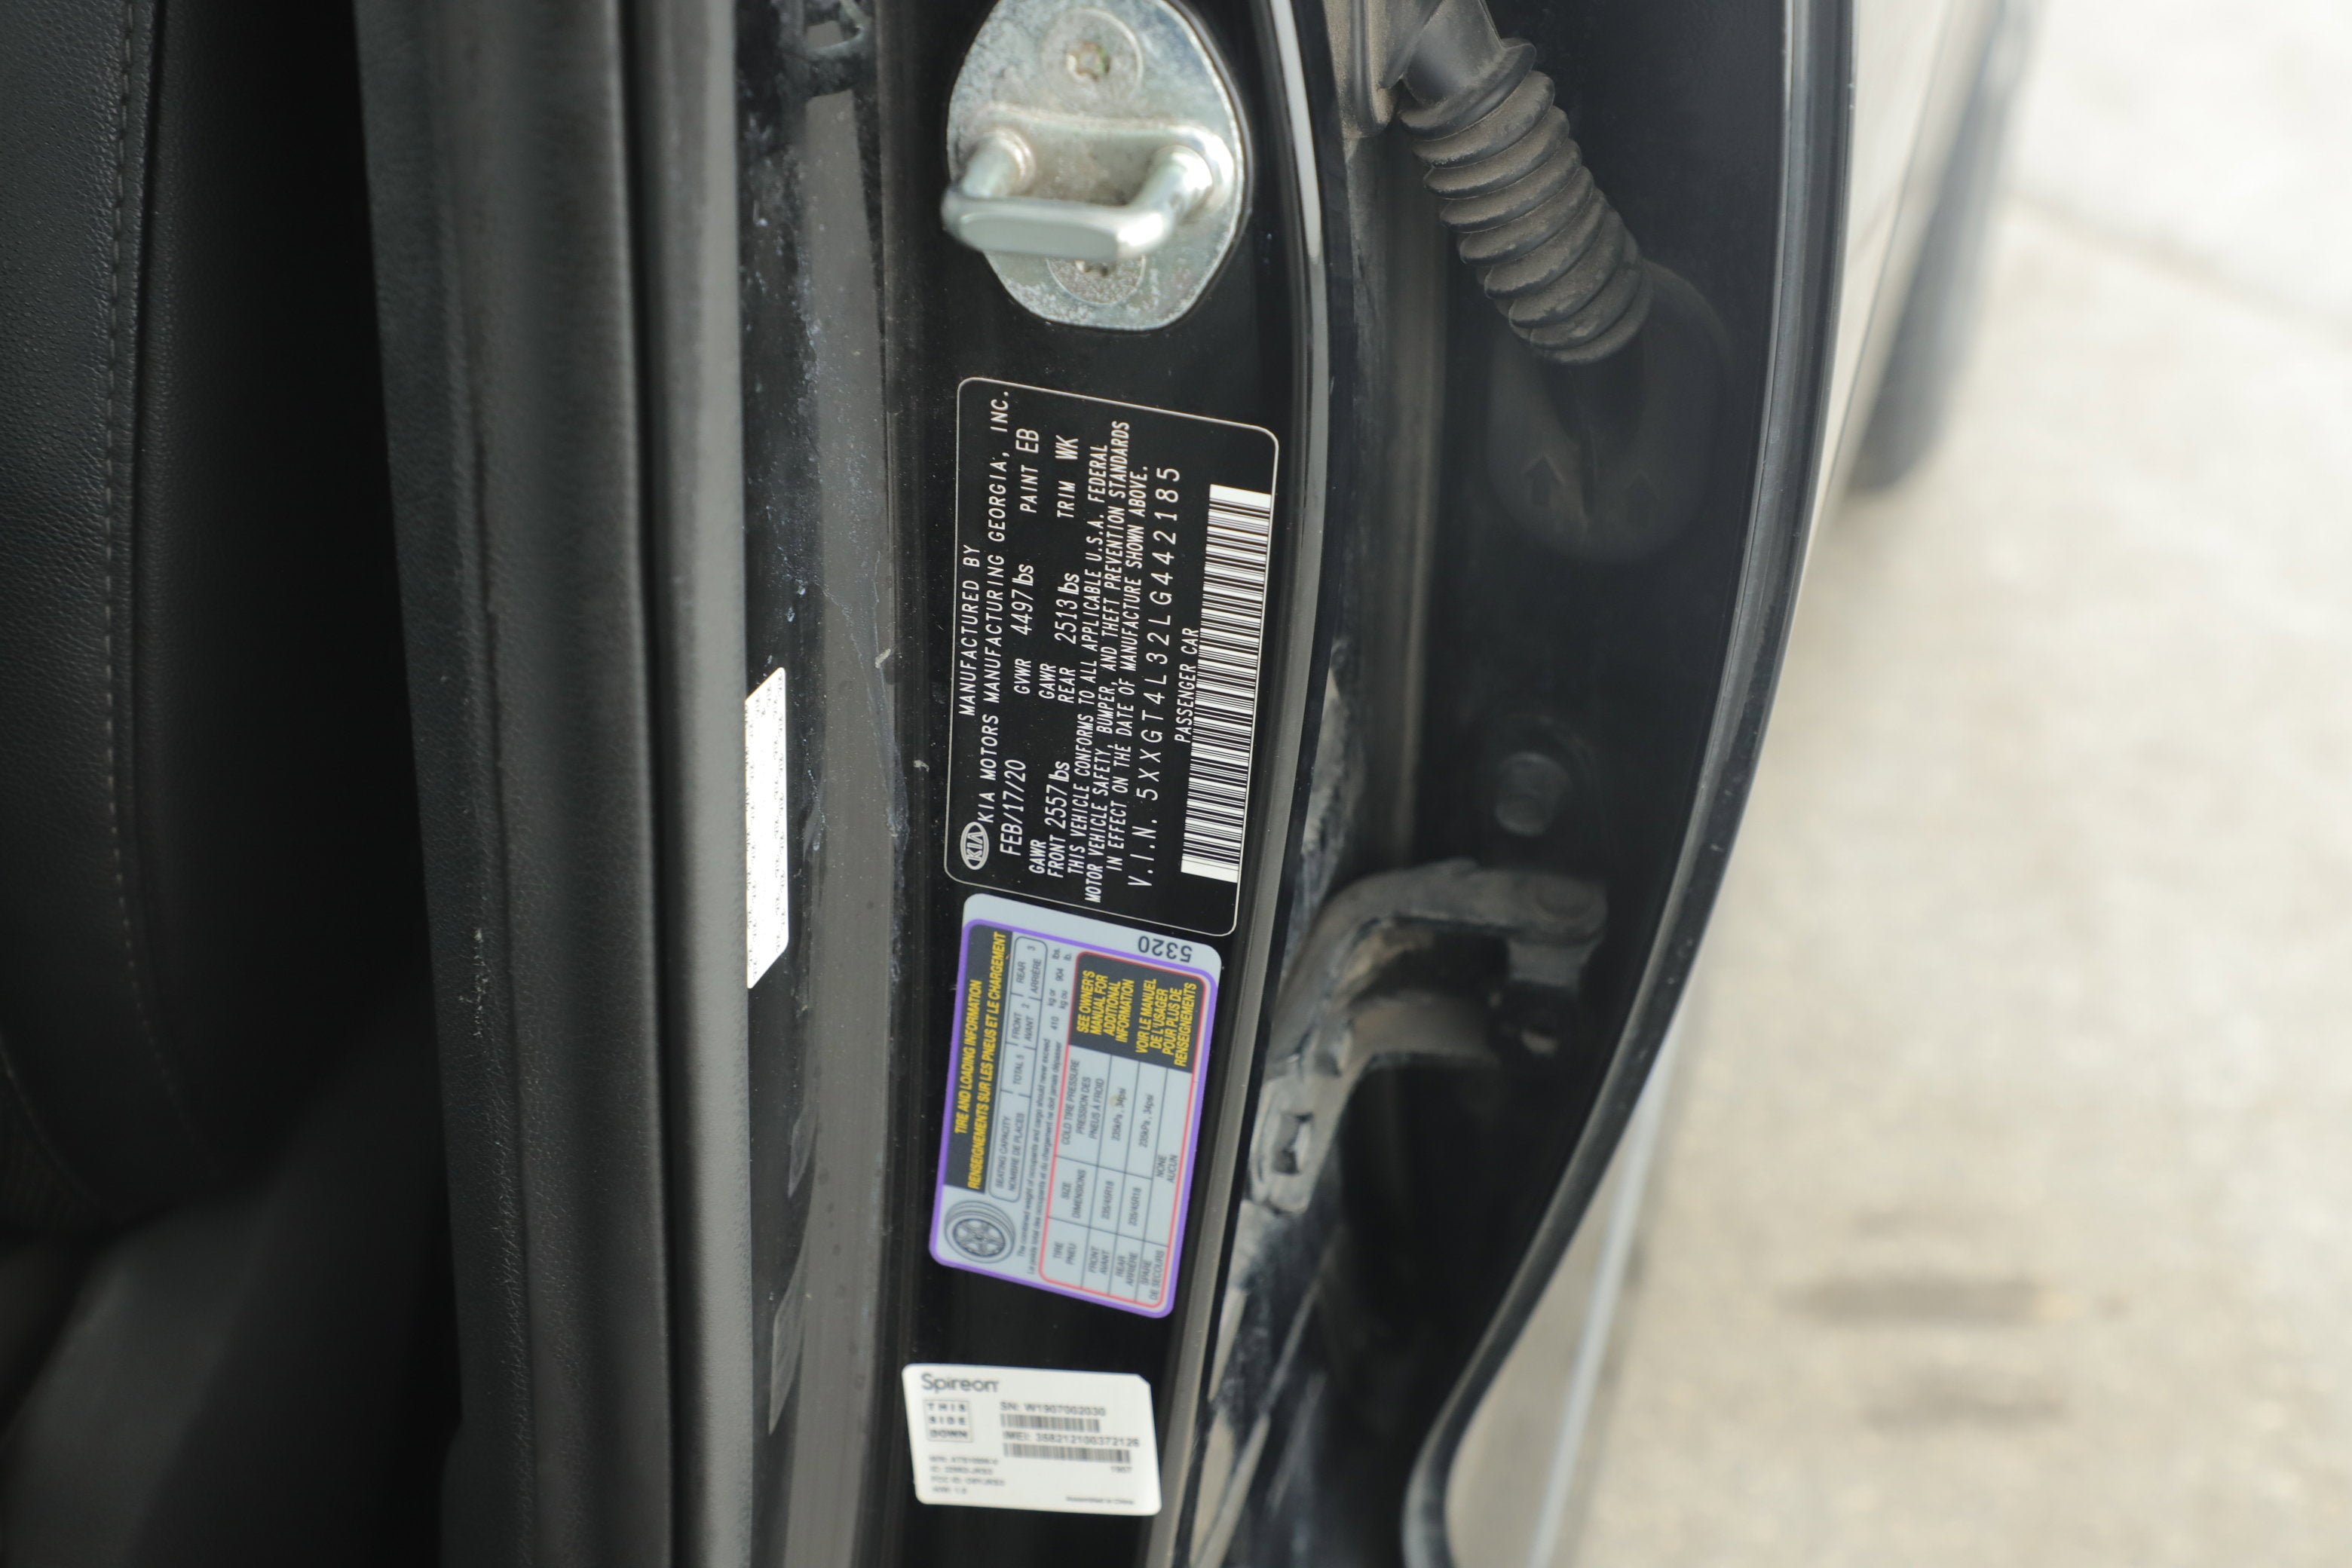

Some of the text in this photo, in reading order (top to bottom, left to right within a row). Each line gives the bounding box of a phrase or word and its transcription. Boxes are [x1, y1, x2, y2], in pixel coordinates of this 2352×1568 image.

[1015, 427, 1039, 513] PAINT EB
[1055, 434, 1078, 519] TRIM WK
[958, 544, 980, 716] MANUFACTURED BY
[978, 388, 1009, 823] KIA MOTORS MANUFACTURING GEORGIA, INC.
[1010, 562, 1034, 694] GVWR 4497 lbs
[1054, 571, 1080, 703] REAR 2513 lbs
[1067, 442, 1107, 875] THIS VEHICLE CONFORMS TO ALL APPLICABLE U.S.A. FEDERAL
[1085, 420, 1129, 903] MOTOR VEHICLE SAFETY, BUMPER, AND THEFT PREVENTION STANDARDS
[1039, 663, 1056, 700] GAWR
[1106, 464, 1148, 871] IN EFFECT ON THE DATE OF MANUFACTURE SHOWN ABOVE.
[1128, 466, 1180, 889] V.I.N. 5XXGT4L32LG442185
[1174, 626, 1199, 743] PASSENGER CAR
[1000, 757, 1026, 856] FEB/17/20
[1044, 759, 1070, 877] FRONT 2557 lbs
[1028, 838, 1046, 874] GAWR
[1016, 960, 1025, 983] REAR
[1028, 957, 1041, 993] ARRIÈRE
[1055, 967, 1064, 982] 904
[1137, 935, 1193, 963] 5320
[1012, 1012, 1021, 1039] FRONT
[1024, 1015, 1034, 1041] AVANT
[1047, 997, 1056, 1006] kg
[1050, 1015, 1059, 1030] 410
[1059, 999, 1067, 1009] kg
[1076, 969, 1095, 1033] SEE OWNER'S
[1089, 973, 1107, 1035] MANUAL FOR
[1102, 978, 1120, 1036] ADDITIONAL
[1115, 978, 1135, 1043] INFORMATION
[1135, 976, 1156, 1054] VOIR LE MANUEL
[1150, 988, 1168, 1049] DE L'USAGER
[1162, 987, 1181, 1055] POUR PLUS DE
[1174, 982, 1196, 1067] RENSEIGNEMENTS
[954, 978, 982, 1135] TIRE AND LOADING INFORMATION
[967, 931, 1006, 1190] RENSEIGNEMENTS SUR LES PNEUS ET LE CHARGEMENT
[1012, 1061, 1023, 1085] TOTAL
[1061, 1058, 1080, 1145] COLD TIRE PRESSURE
[1076, 1076, 1091, 1135] PRESSION DES
[1092, 1077, 1104, 1103] FROID
[1116, 1087, 1128, 1108] 34psi
[1143, 1093, 1155, 1115] 34psi
[1008, 1112, 1024, 1192] NOMBRE DE PLACES
[1088, 1111, 1100, 1139] PNEUS
[1111, 1113, 1122, 1141] 235kPa
[1138, 1119, 1150, 1147] 235kPa
[995, 1116, 1011, 1189] SEATING CAPACITY
[1156, 1154, 1166, 1178] NONE
[1165, 1153, 1178, 1183] AUCUN
[1071, 1168, 1086, 1218] DIMENSIONS
[1088, 1245, 1099, 1273] FRONT
[1099, 1249, 1110, 1275] AVANT
[1115, 1254, 1125, 1277] REAR
[1140, 1260, 1151, 1285] SPARE
[1150, 1249, 1164, 1300] DE SECOURS
[920, 1373, 998, 1396] Spireon
